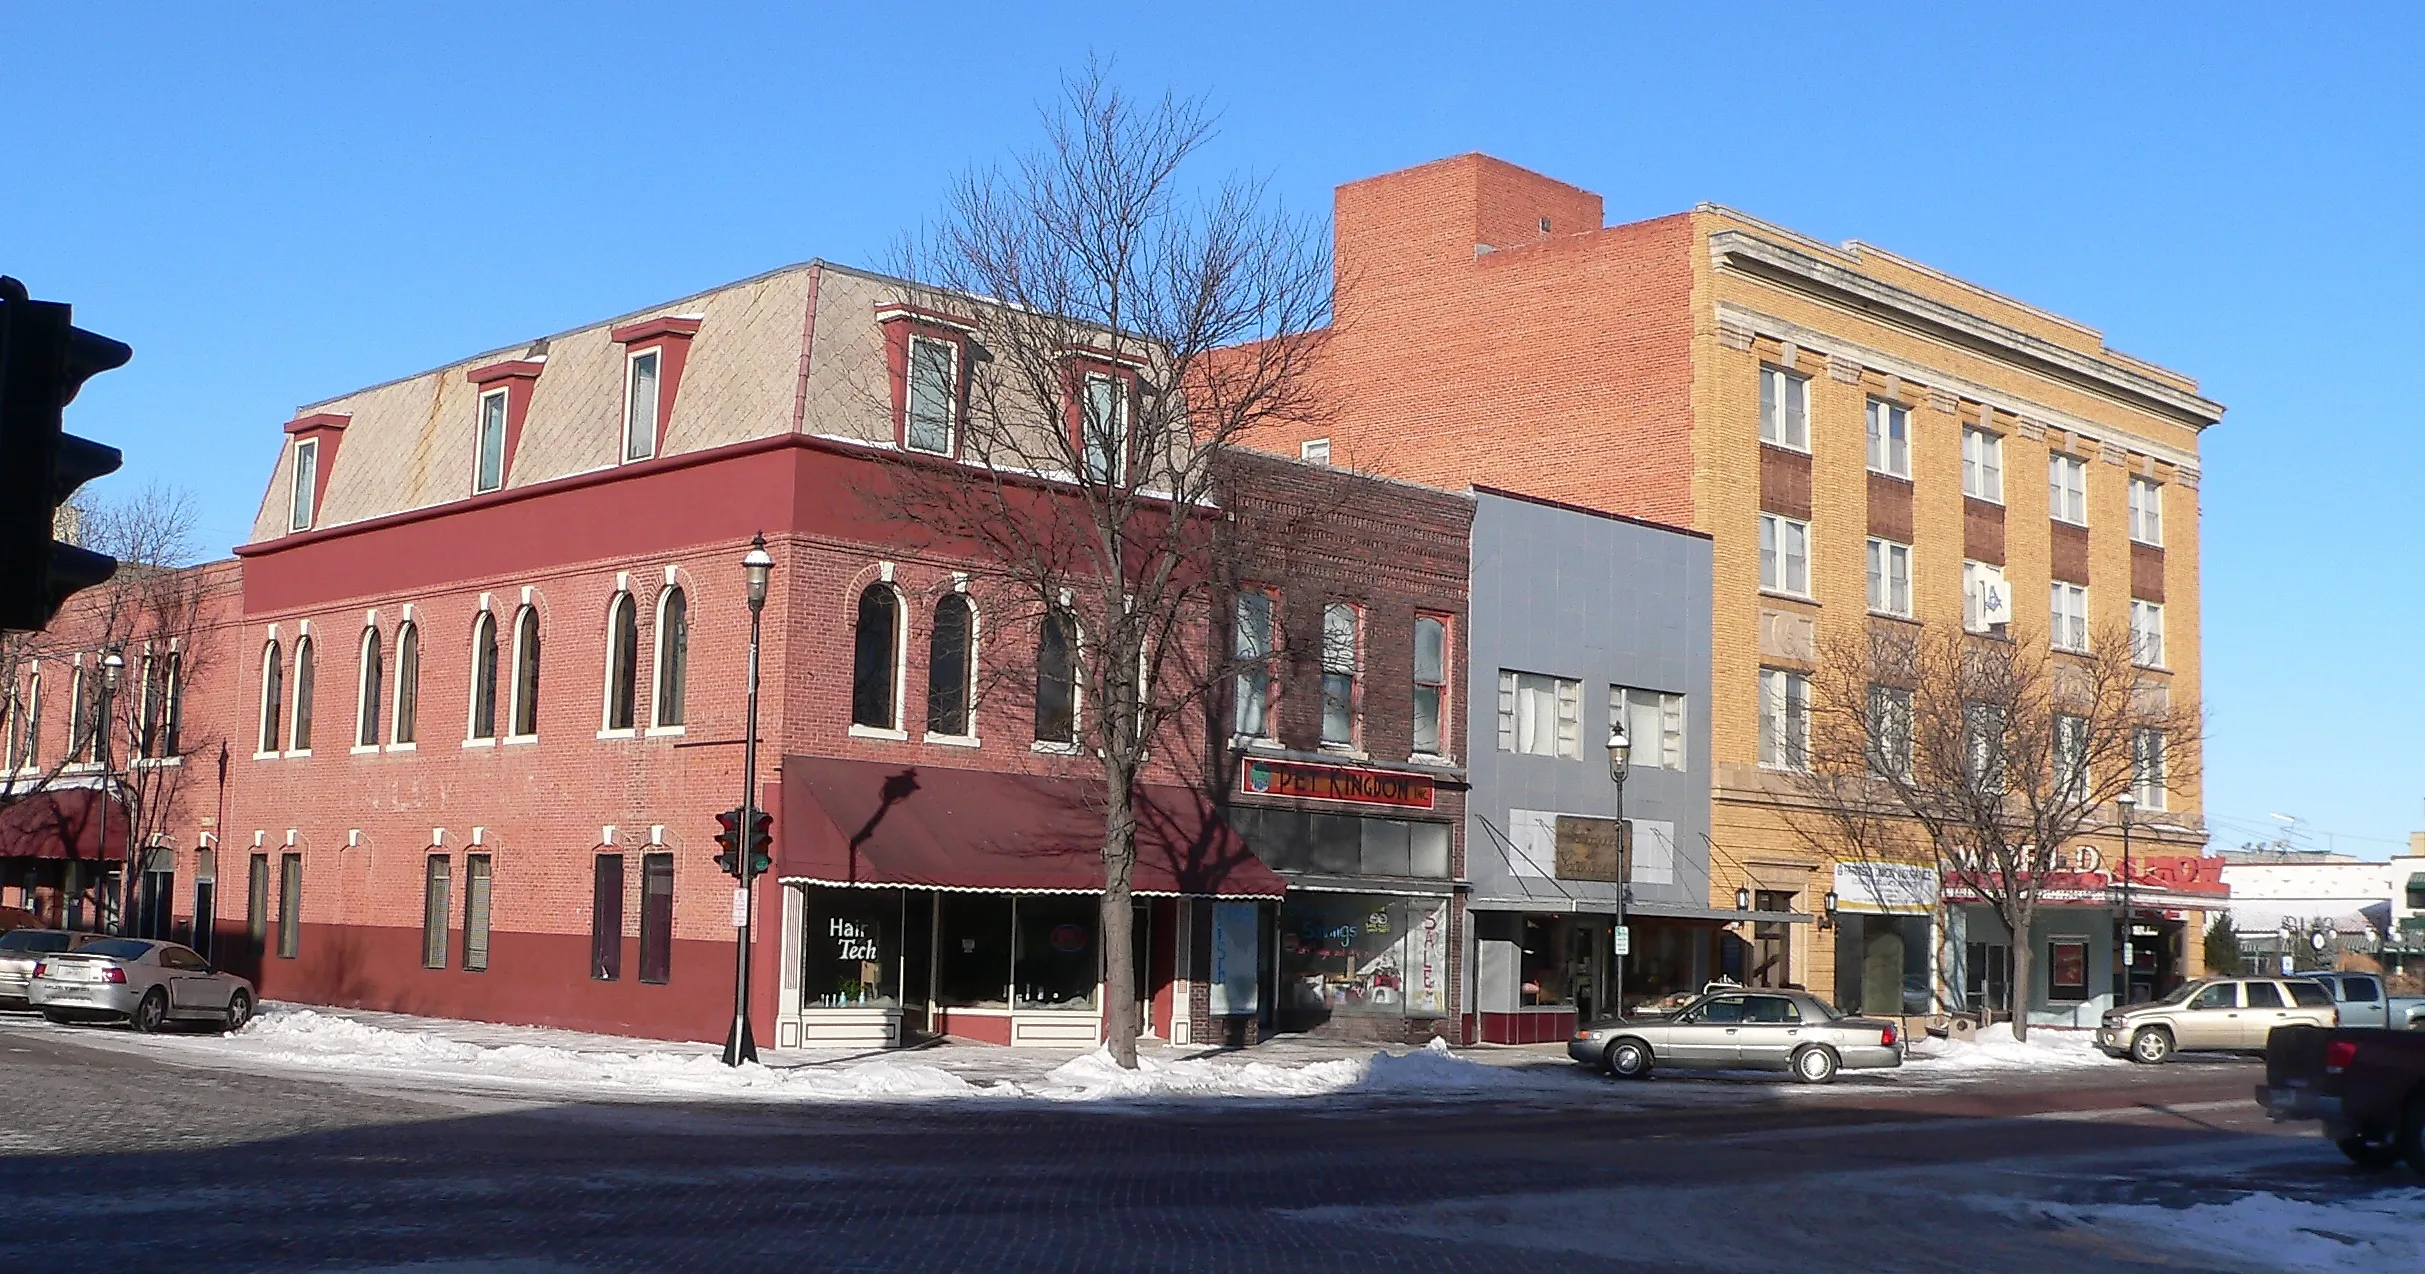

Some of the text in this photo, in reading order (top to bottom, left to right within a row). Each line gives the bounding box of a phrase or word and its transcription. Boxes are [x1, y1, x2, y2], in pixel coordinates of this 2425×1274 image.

[1279, 767, 1318, 794] PET
[1329, 769, 1409, 801] KINGDOM
[828, 917, 869, 938] Hair
[837, 938, 878, 961] Tech
[1423, 909, 1438, 988] SALE
